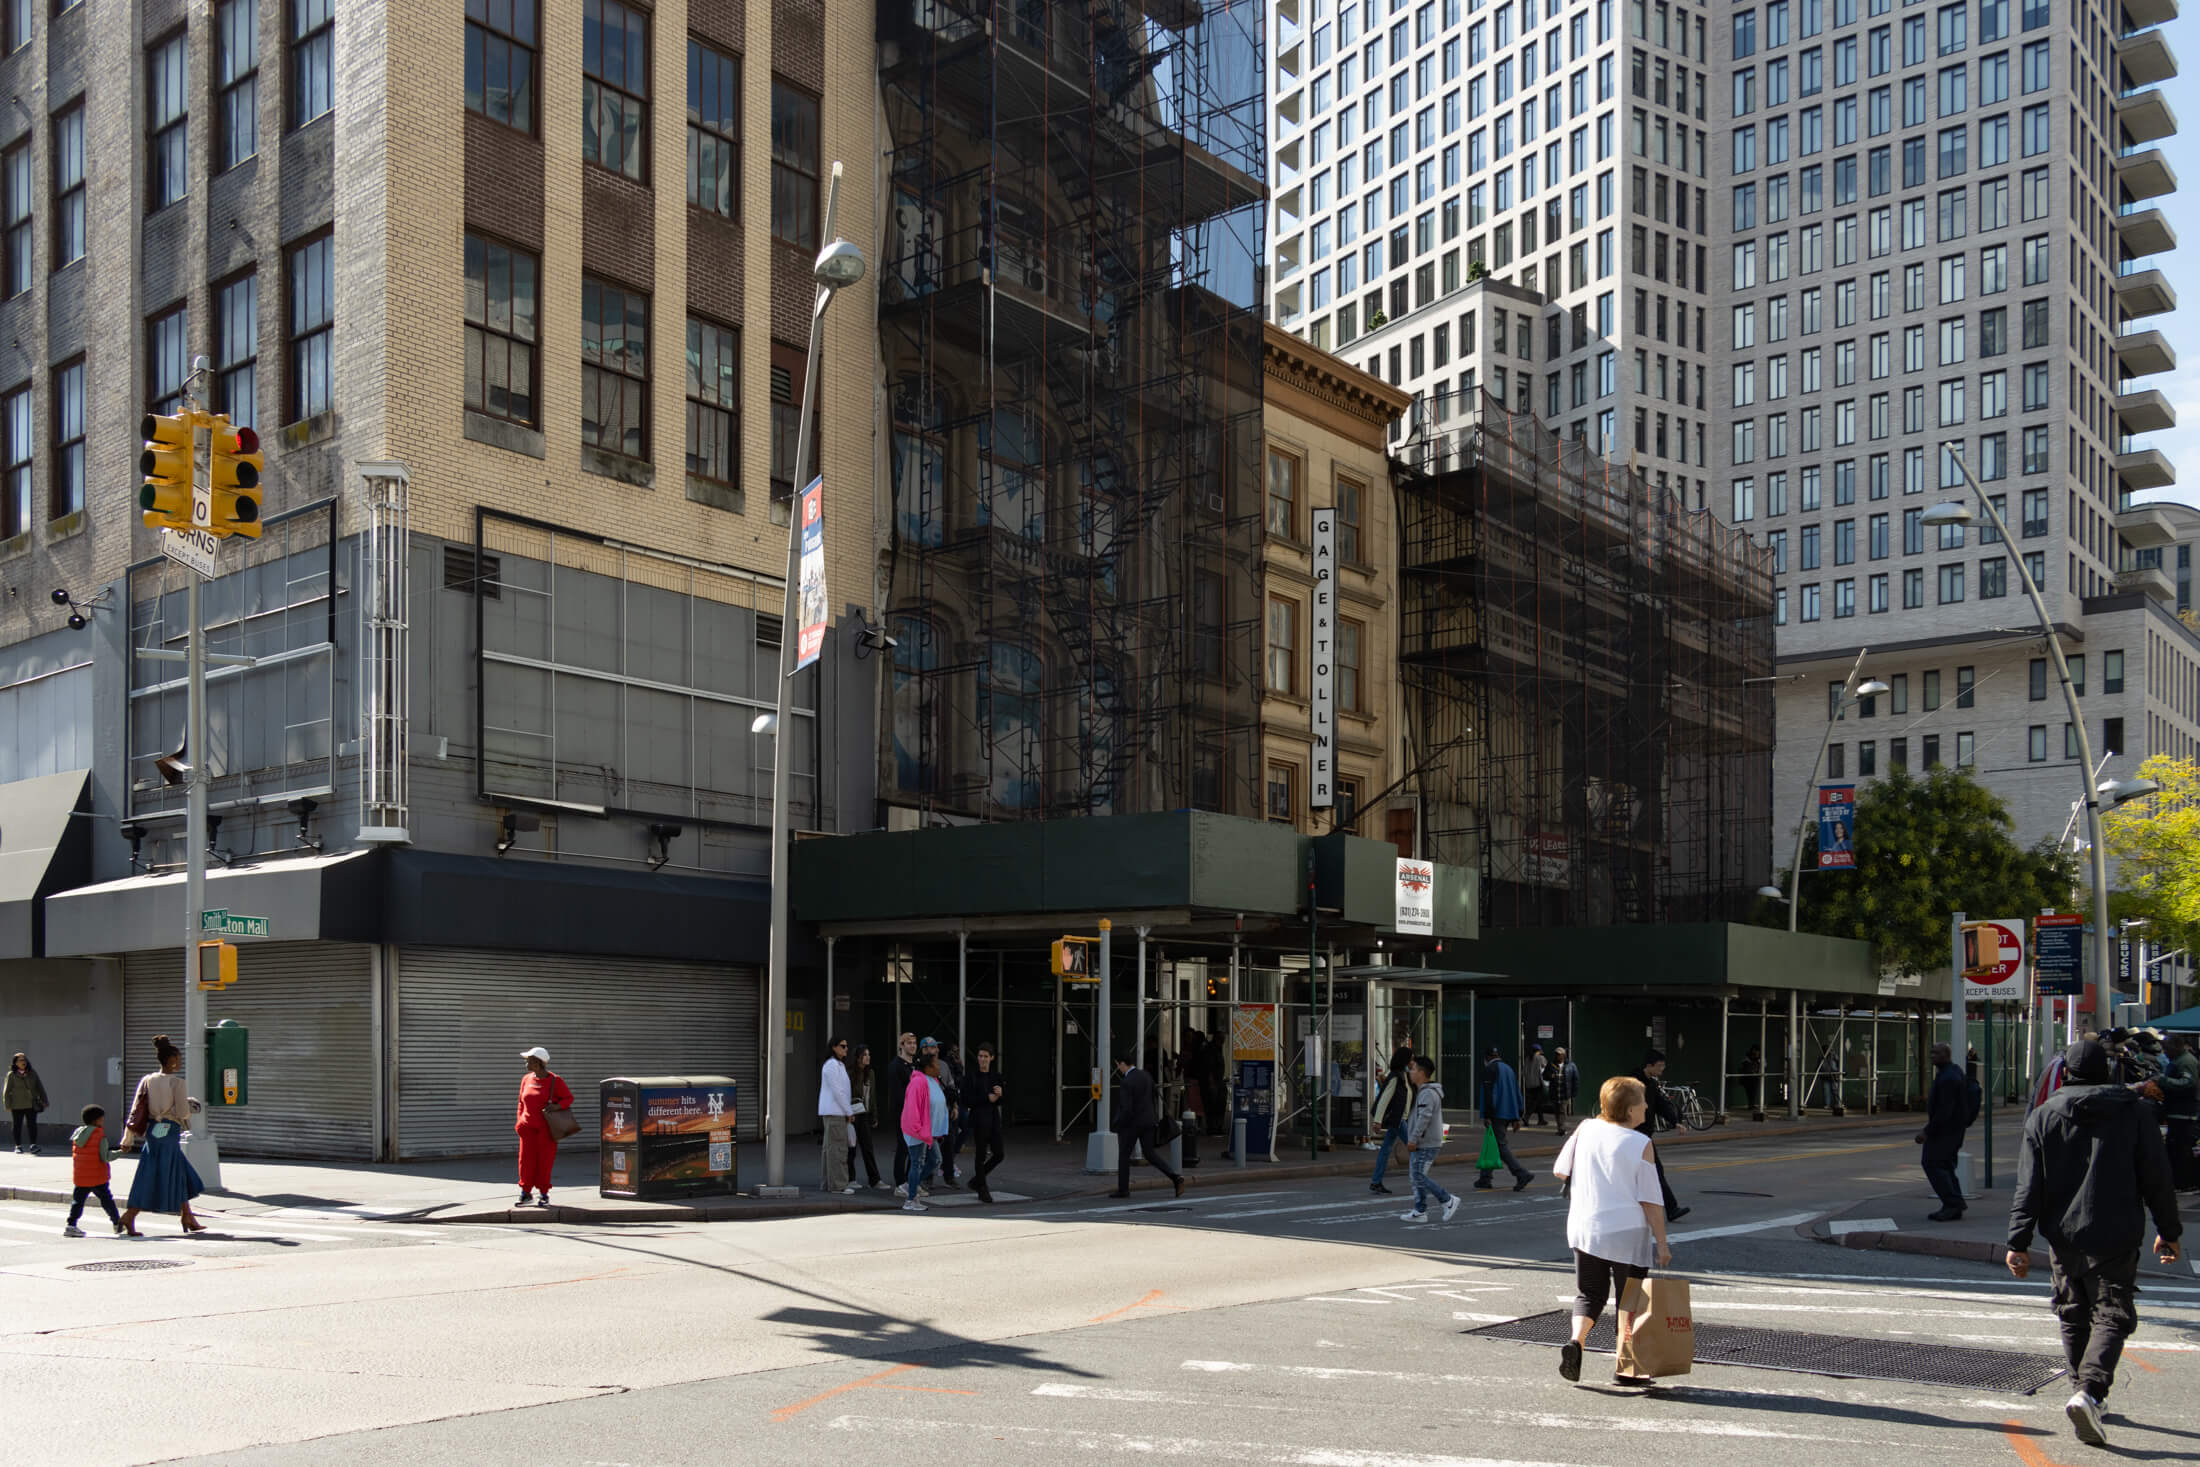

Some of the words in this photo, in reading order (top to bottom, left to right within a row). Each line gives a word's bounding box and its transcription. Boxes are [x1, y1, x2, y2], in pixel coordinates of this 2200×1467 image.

[193, 497, 207, 521] O
[171, 529, 215, 554] URNS
[1317, 520, 1329, 605] GAGE
[1318, 617, 1328, 628] &
[1317, 639, 1329, 796] TOLLNER
[1401, 873, 1430, 883] ARSENAL
[204, 913, 221, 929] Smith
[247, 920, 267, 936] Mall
[1991, 986, 2017, 996] BUSES
[648, 1097, 680, 1106] summer
[681, 1095, 697, 1105] hits
[647, 1106, 682, 1117] different
[683, 1105, 703, 1116] here.
